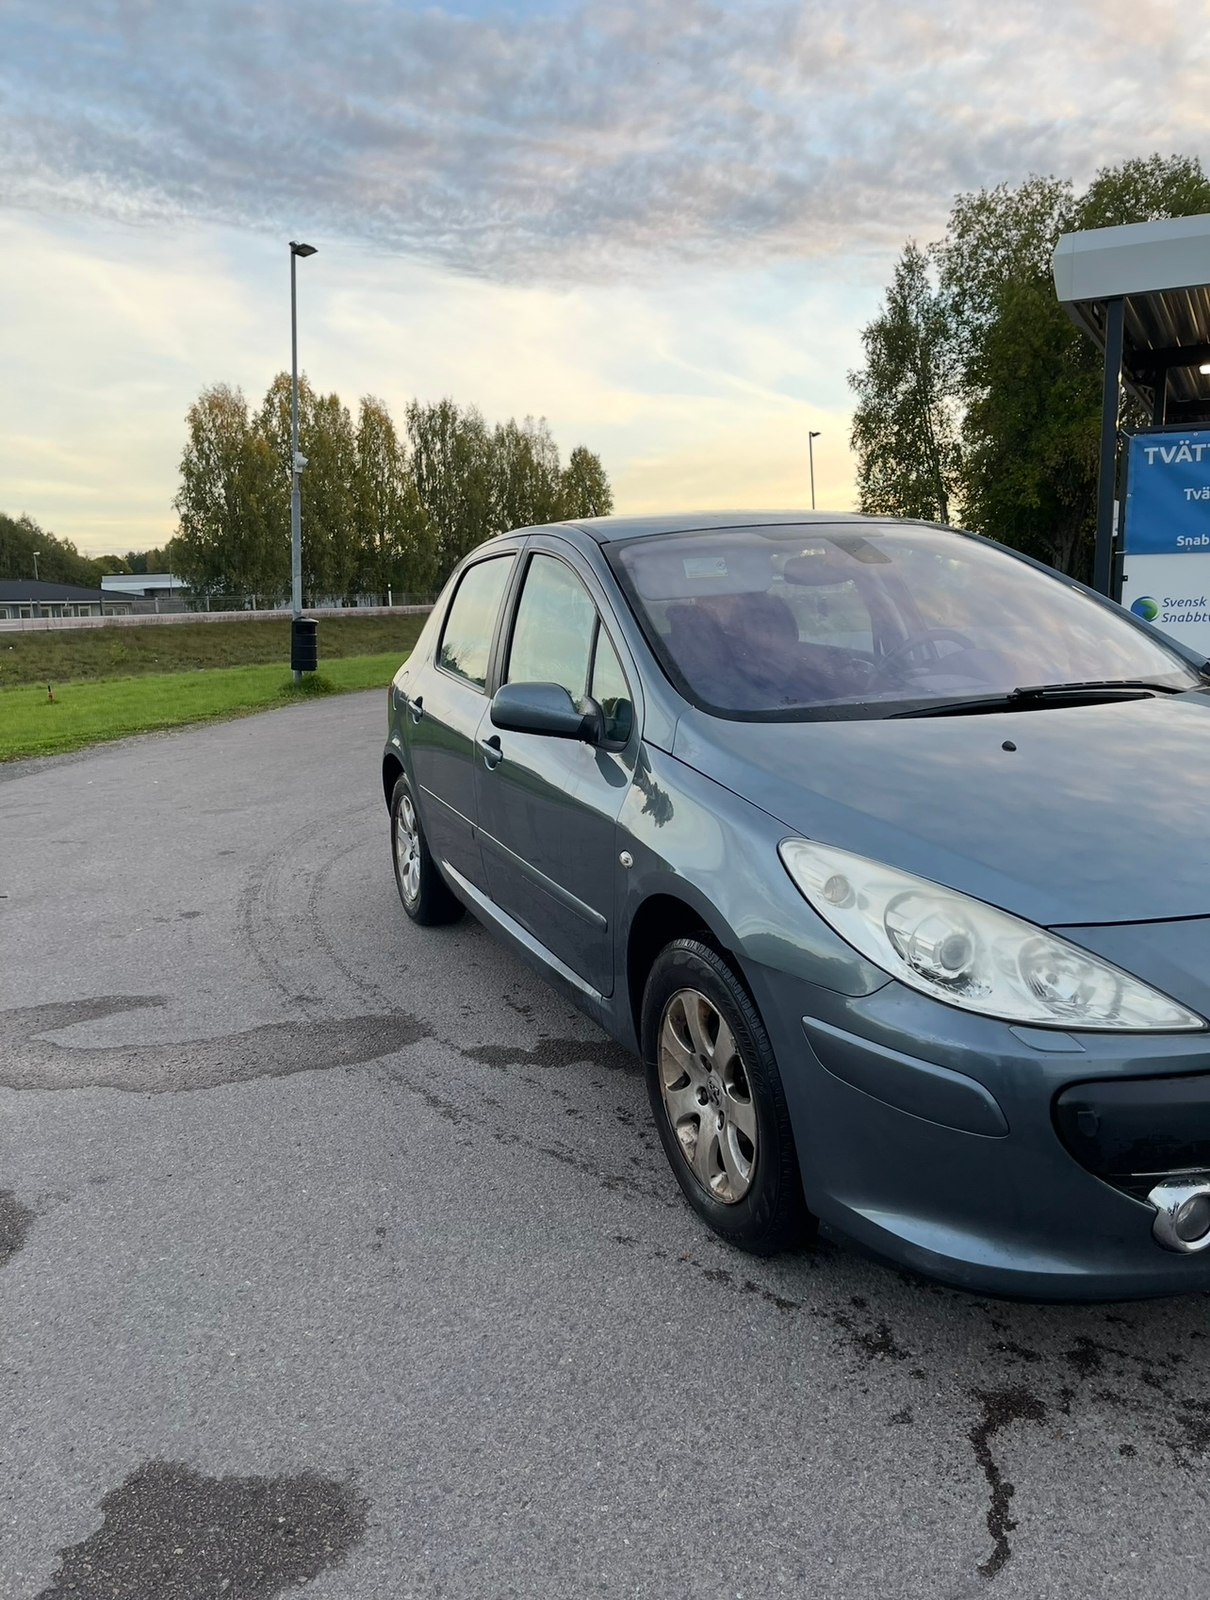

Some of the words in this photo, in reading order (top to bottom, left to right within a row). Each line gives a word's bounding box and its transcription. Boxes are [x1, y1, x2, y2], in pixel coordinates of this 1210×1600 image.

[1144, 440, 1210, 464] TVÄT
[1184, 487, 1210, 500] Tvä
[1176, 534, 1210, 546] Snab
[1162, 596, 1207, 607] Svensk
[1161, 612, 1210, 622] Snabbt
